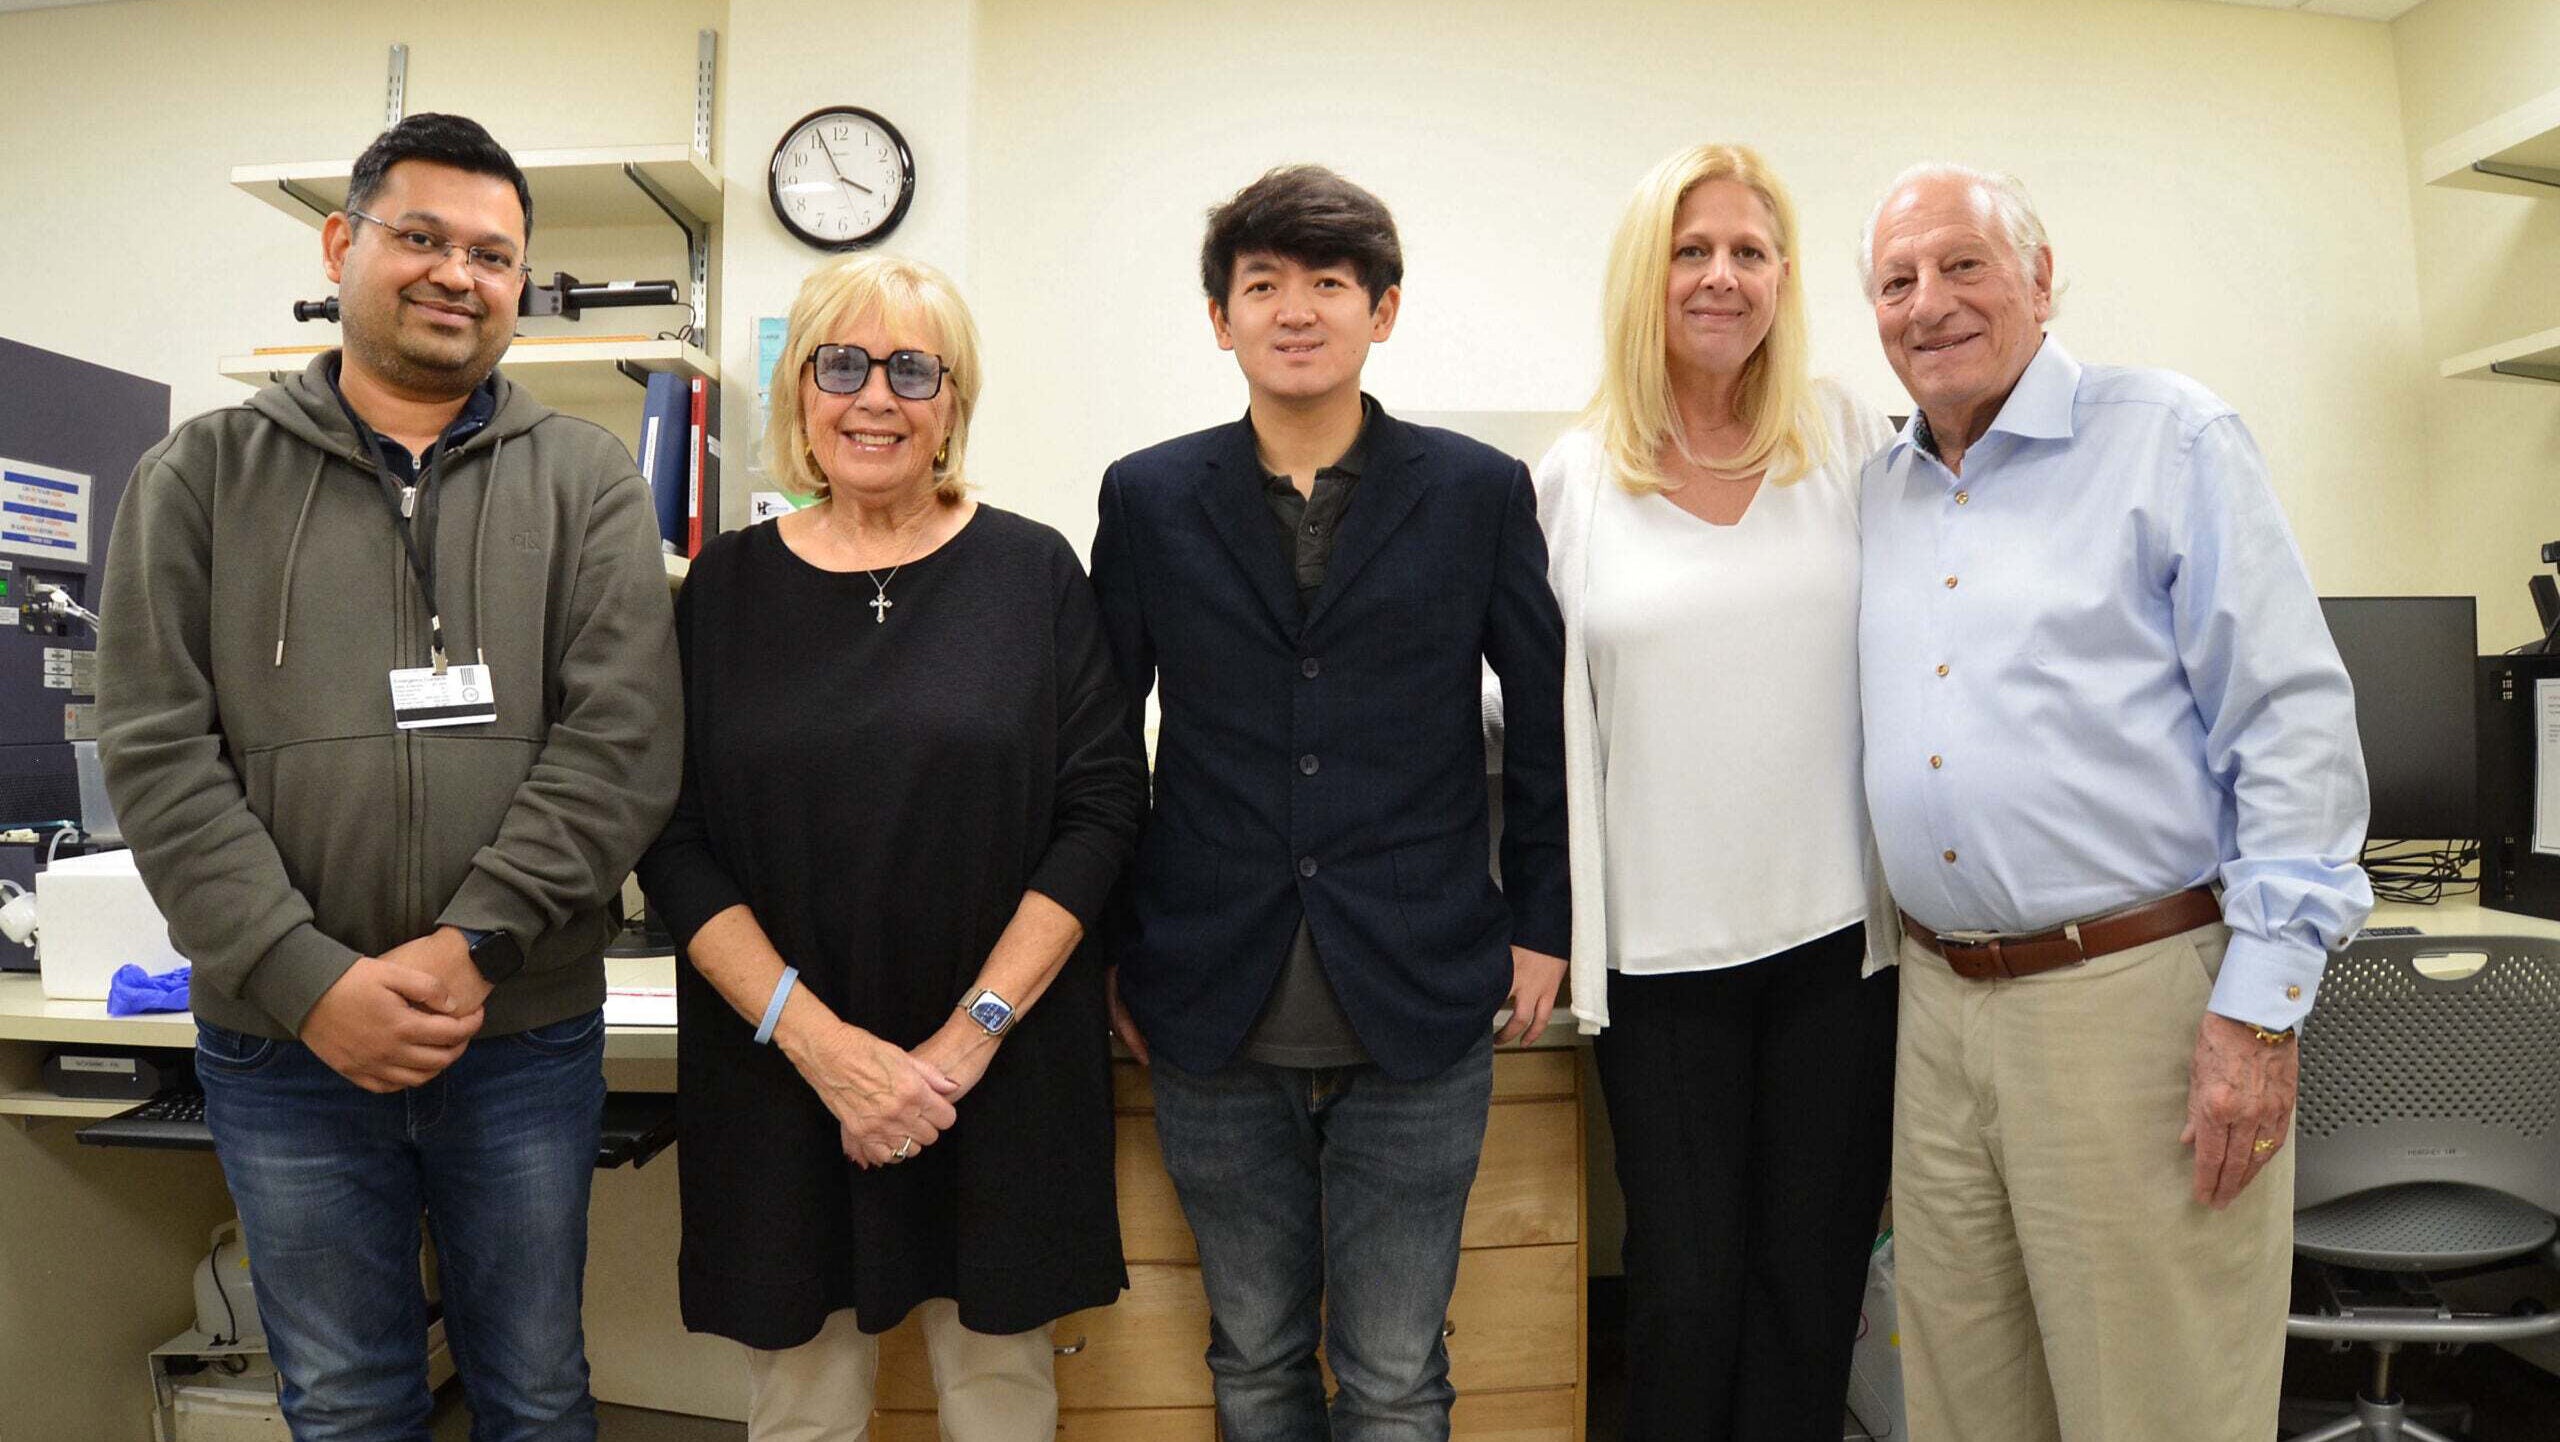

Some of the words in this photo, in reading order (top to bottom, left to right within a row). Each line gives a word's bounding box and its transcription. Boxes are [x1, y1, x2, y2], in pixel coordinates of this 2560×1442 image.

[833, 126, 848, 141] 12
[864, 131, 869, 147] 1
[811, 134, 822, 149] 11
[794, 152, 808, 167] 10
[878, 148, 888, 162] 2
[885, 169, 895, 184] 3
[796, 197, 806, 212] 8
[816, 212, 825, 228] 7
[838, 216, 848, 232] 6
[861, 210, 870, 225] 5
